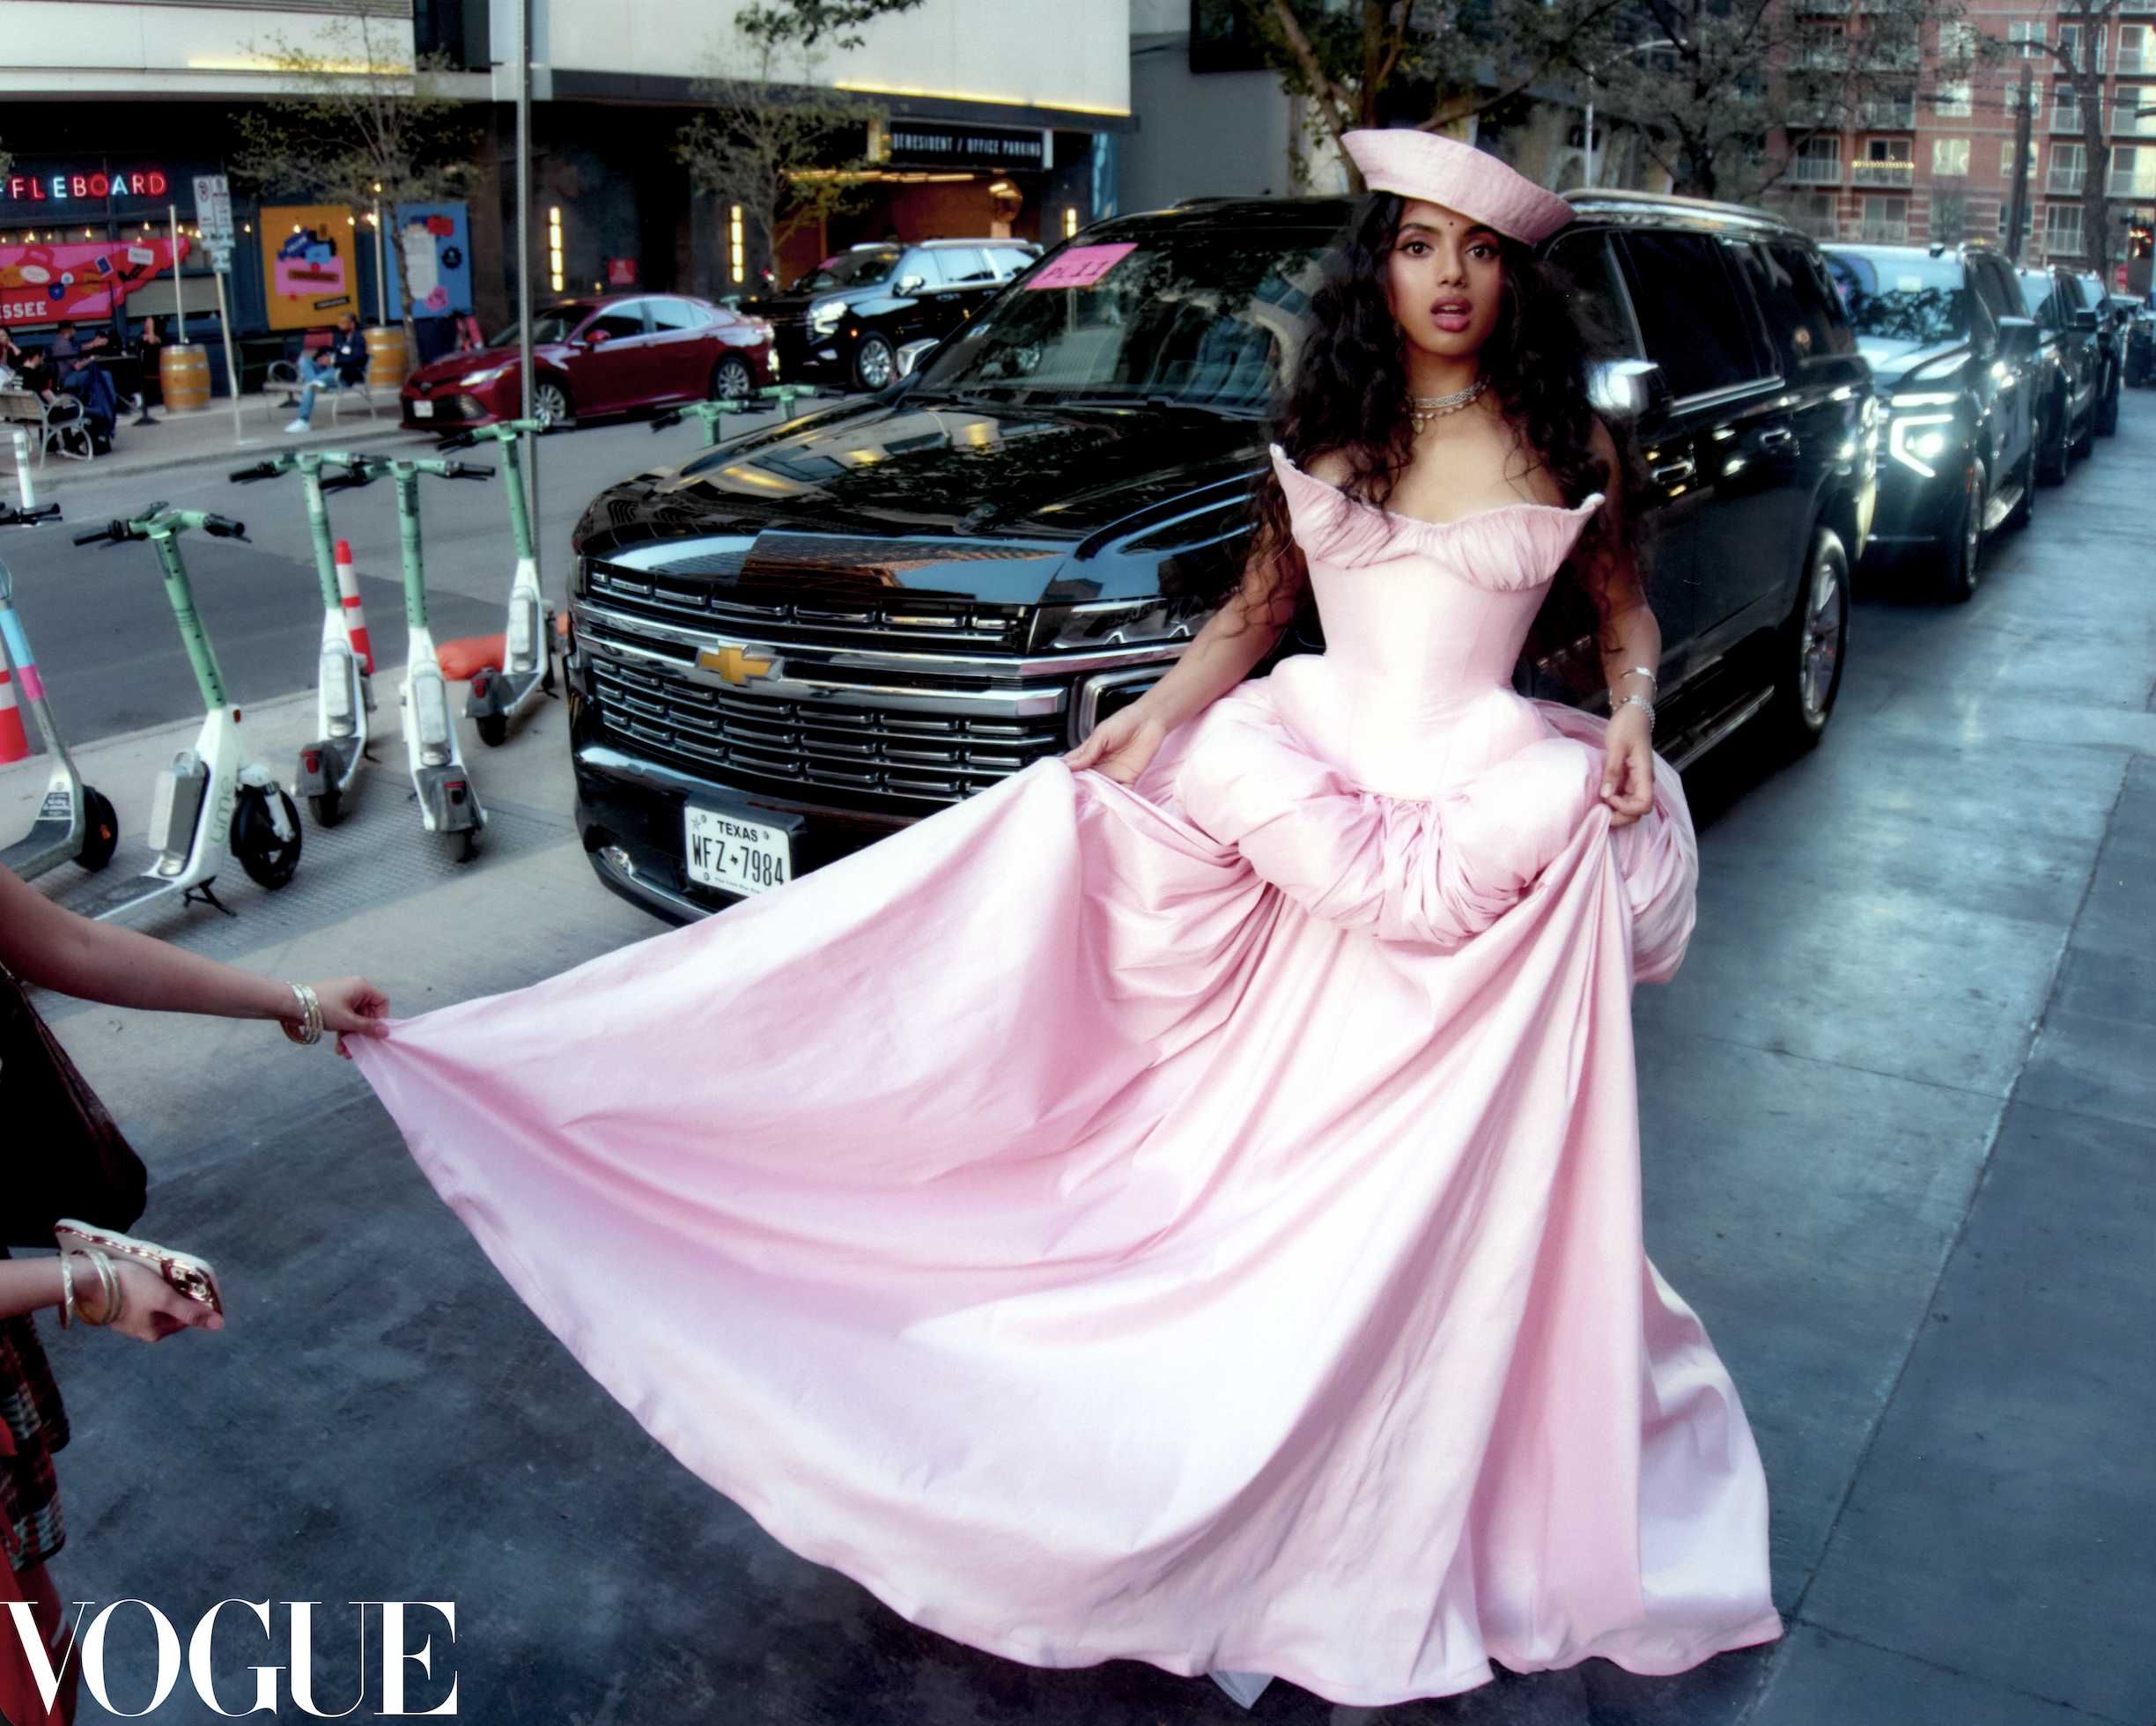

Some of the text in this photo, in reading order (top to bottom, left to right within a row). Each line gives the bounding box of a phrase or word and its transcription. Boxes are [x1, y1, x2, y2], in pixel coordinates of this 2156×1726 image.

[1001, 140, 1042, 159] PARKING
[0, 173, 166, 200] FLEBOARD
[0, 300, 48, 320] SSEE
[717, 820, 758, 843] TEXAS
[692, 833, 785, 887] WFZ 7984
